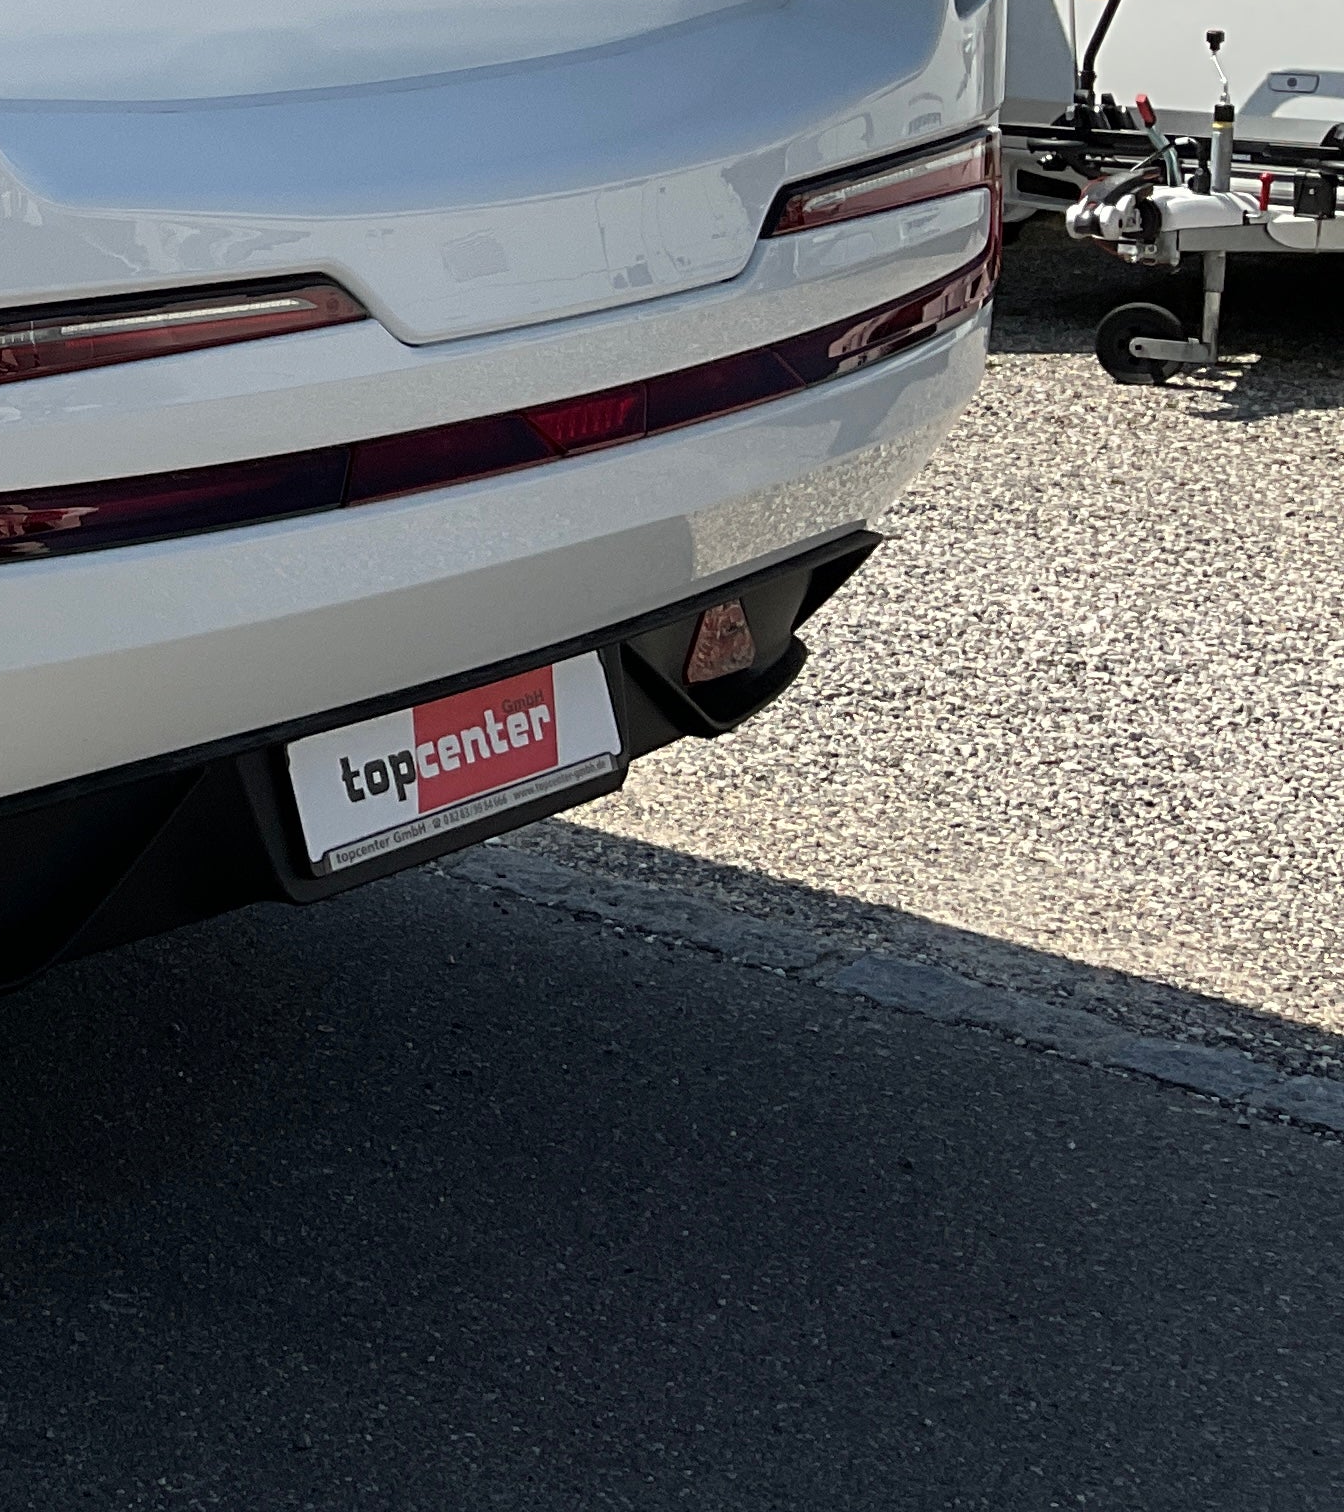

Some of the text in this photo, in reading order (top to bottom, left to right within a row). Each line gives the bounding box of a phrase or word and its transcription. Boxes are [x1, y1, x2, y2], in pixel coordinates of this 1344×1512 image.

[502, 690, 544, 714] GmbH
[339, 703, 551, 803] topcenter
[335, 836, 391, 865] topcenter
[393, 823, 427, 844] GmbH
